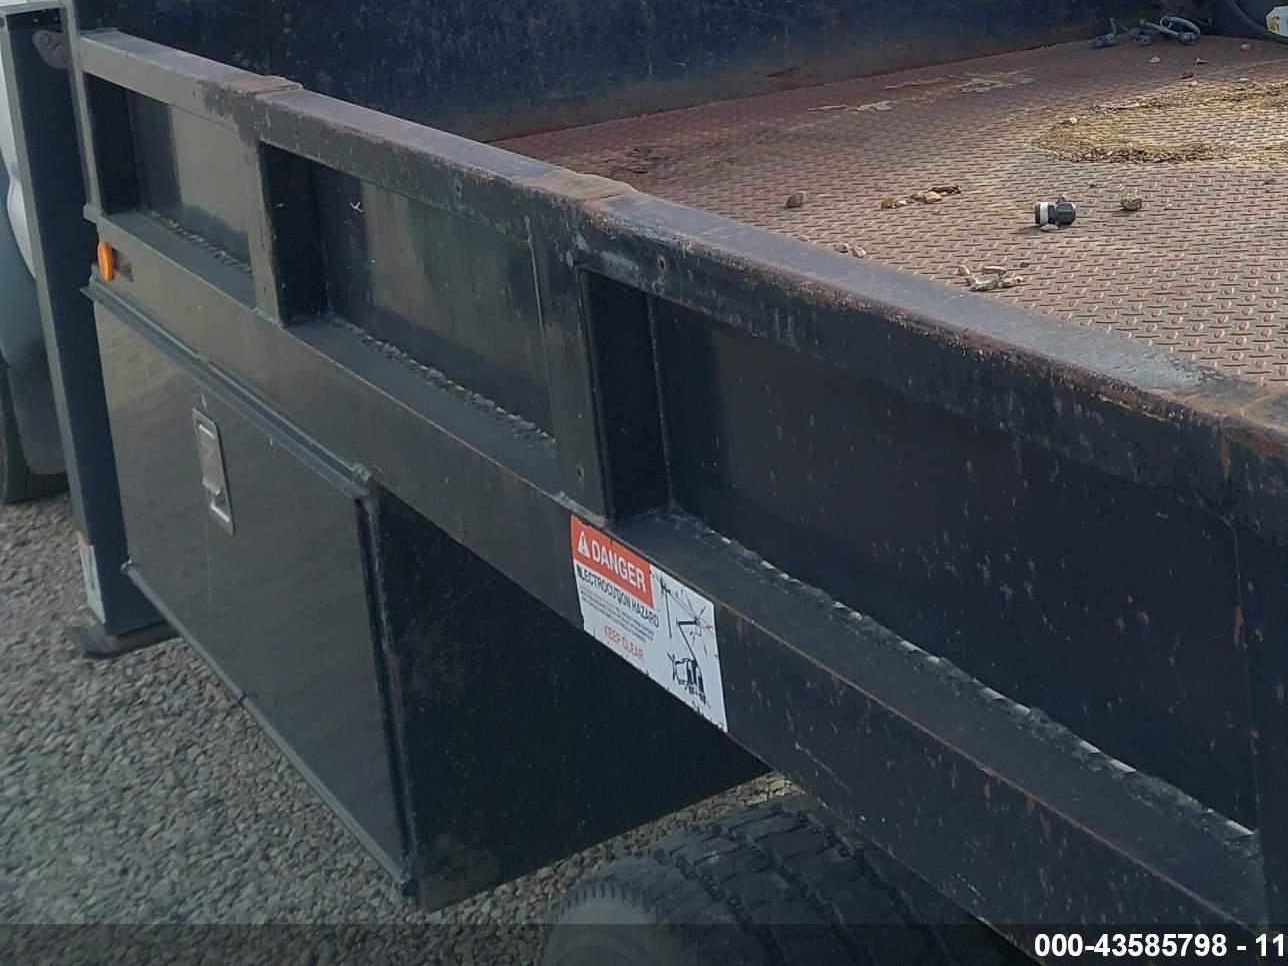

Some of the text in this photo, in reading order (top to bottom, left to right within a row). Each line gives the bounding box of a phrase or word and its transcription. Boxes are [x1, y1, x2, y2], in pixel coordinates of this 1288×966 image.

[591, 540, 647, 593] DANGER
[631, 599, 660, 628] HAZARD
[604, 625, 645, 661] KEEP CLEAR
